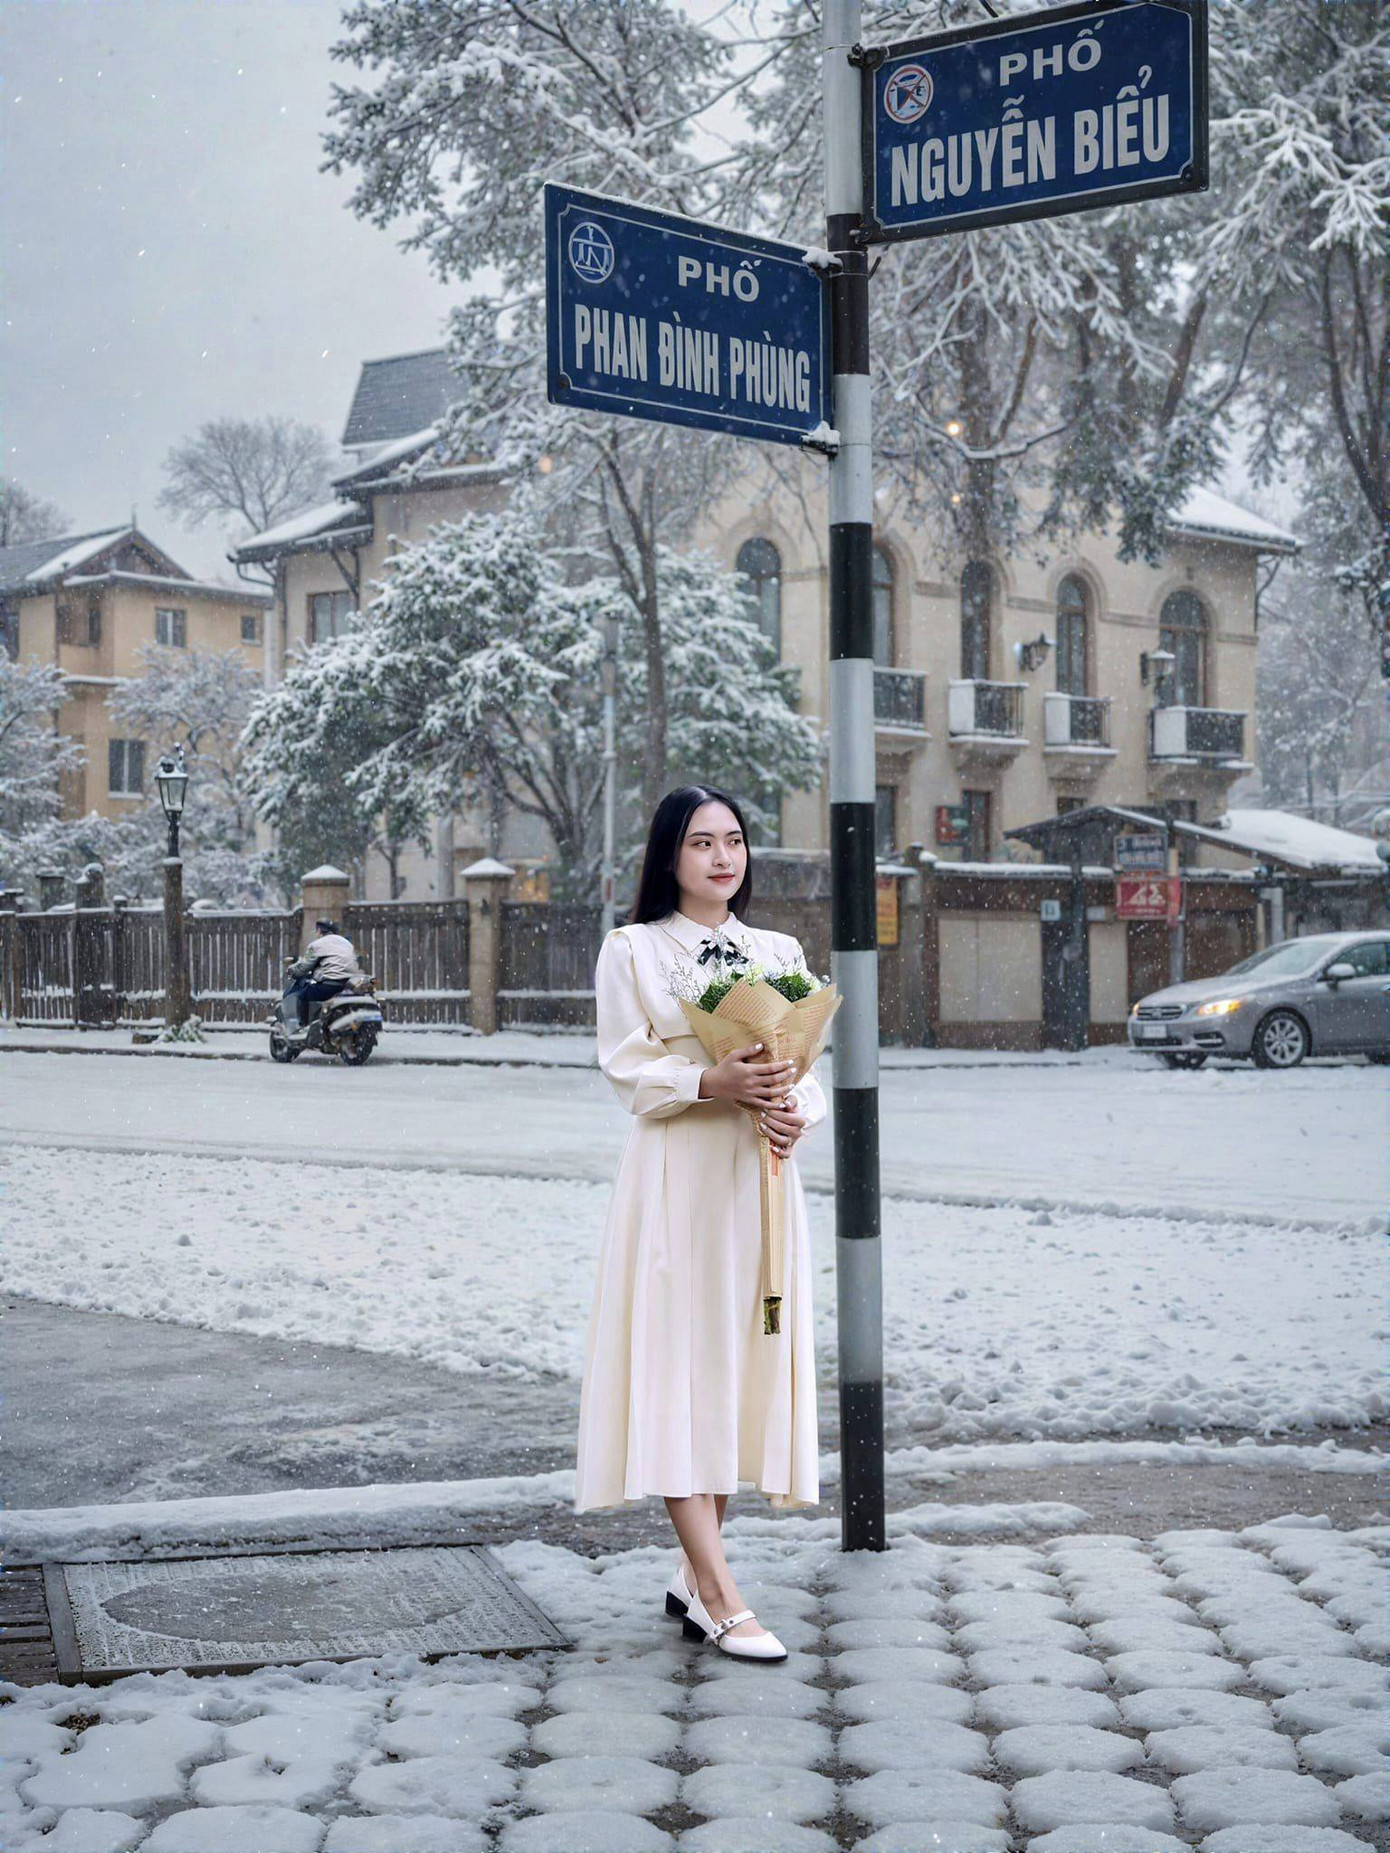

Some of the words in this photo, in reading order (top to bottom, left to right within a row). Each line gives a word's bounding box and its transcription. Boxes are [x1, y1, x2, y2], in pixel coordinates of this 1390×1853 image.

[1000, 20, 1104, 87] PHỐ
[891, 94, 1057, 207] NGUYỄN
[1074, 64, 1170, 175] BIỂU
[678, 255, 761, 302] PHỐ
[575, 303, 648, 382] PHAN
[657, 311, 720, 397] ĐÌNH
[729, 331, 810, 413] PHÙNG
